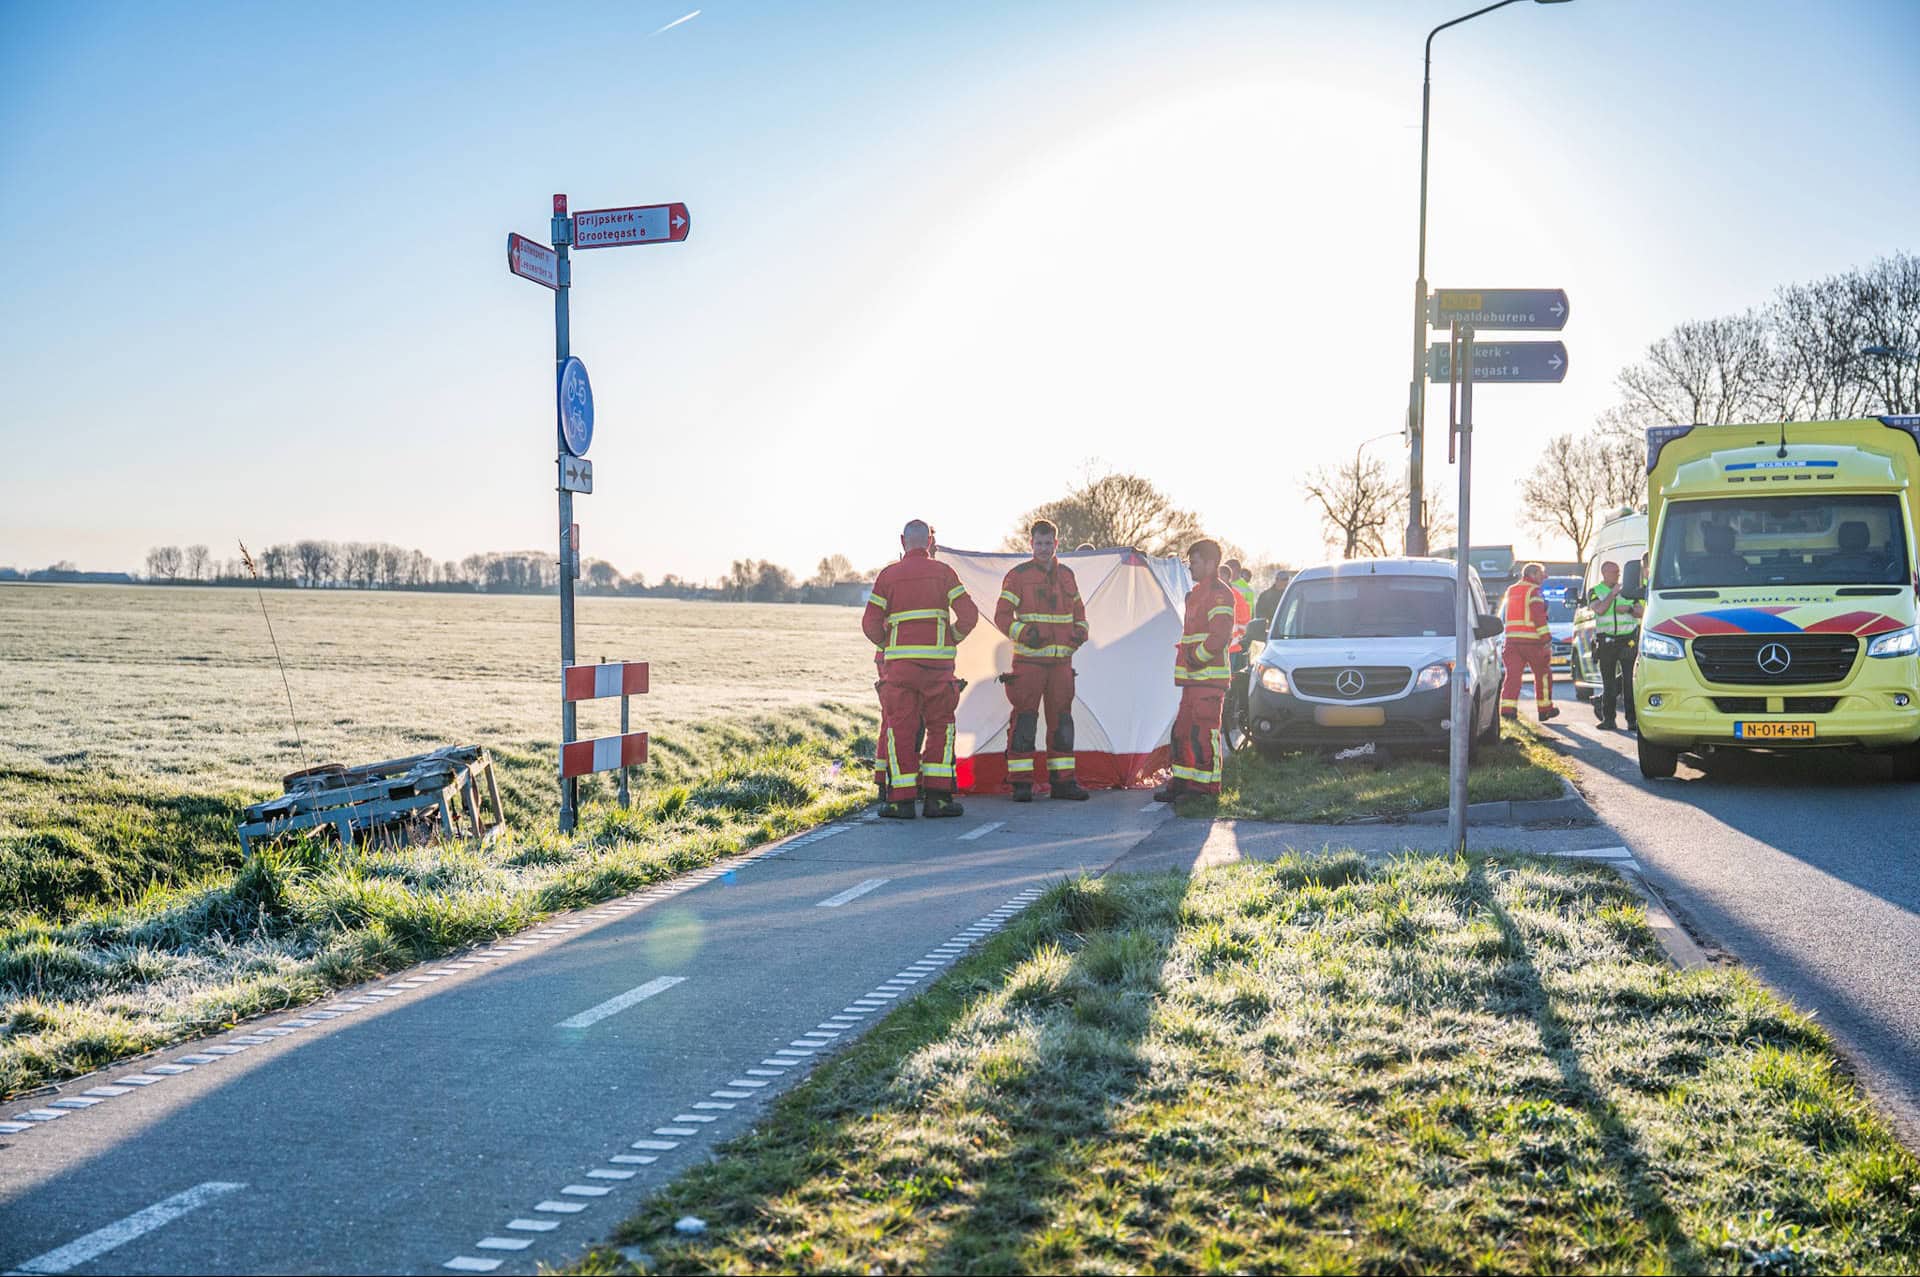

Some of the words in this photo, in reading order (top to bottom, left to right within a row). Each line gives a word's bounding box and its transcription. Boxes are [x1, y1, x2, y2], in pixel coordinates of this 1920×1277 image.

[578, 212, 634, 227] Grijpskerk
[578, 228, 637, 241] Grootegast
[1720, 596, 1834, 605] AMBULANCE
[1747, 724, 1811, 737] N-014-RH
